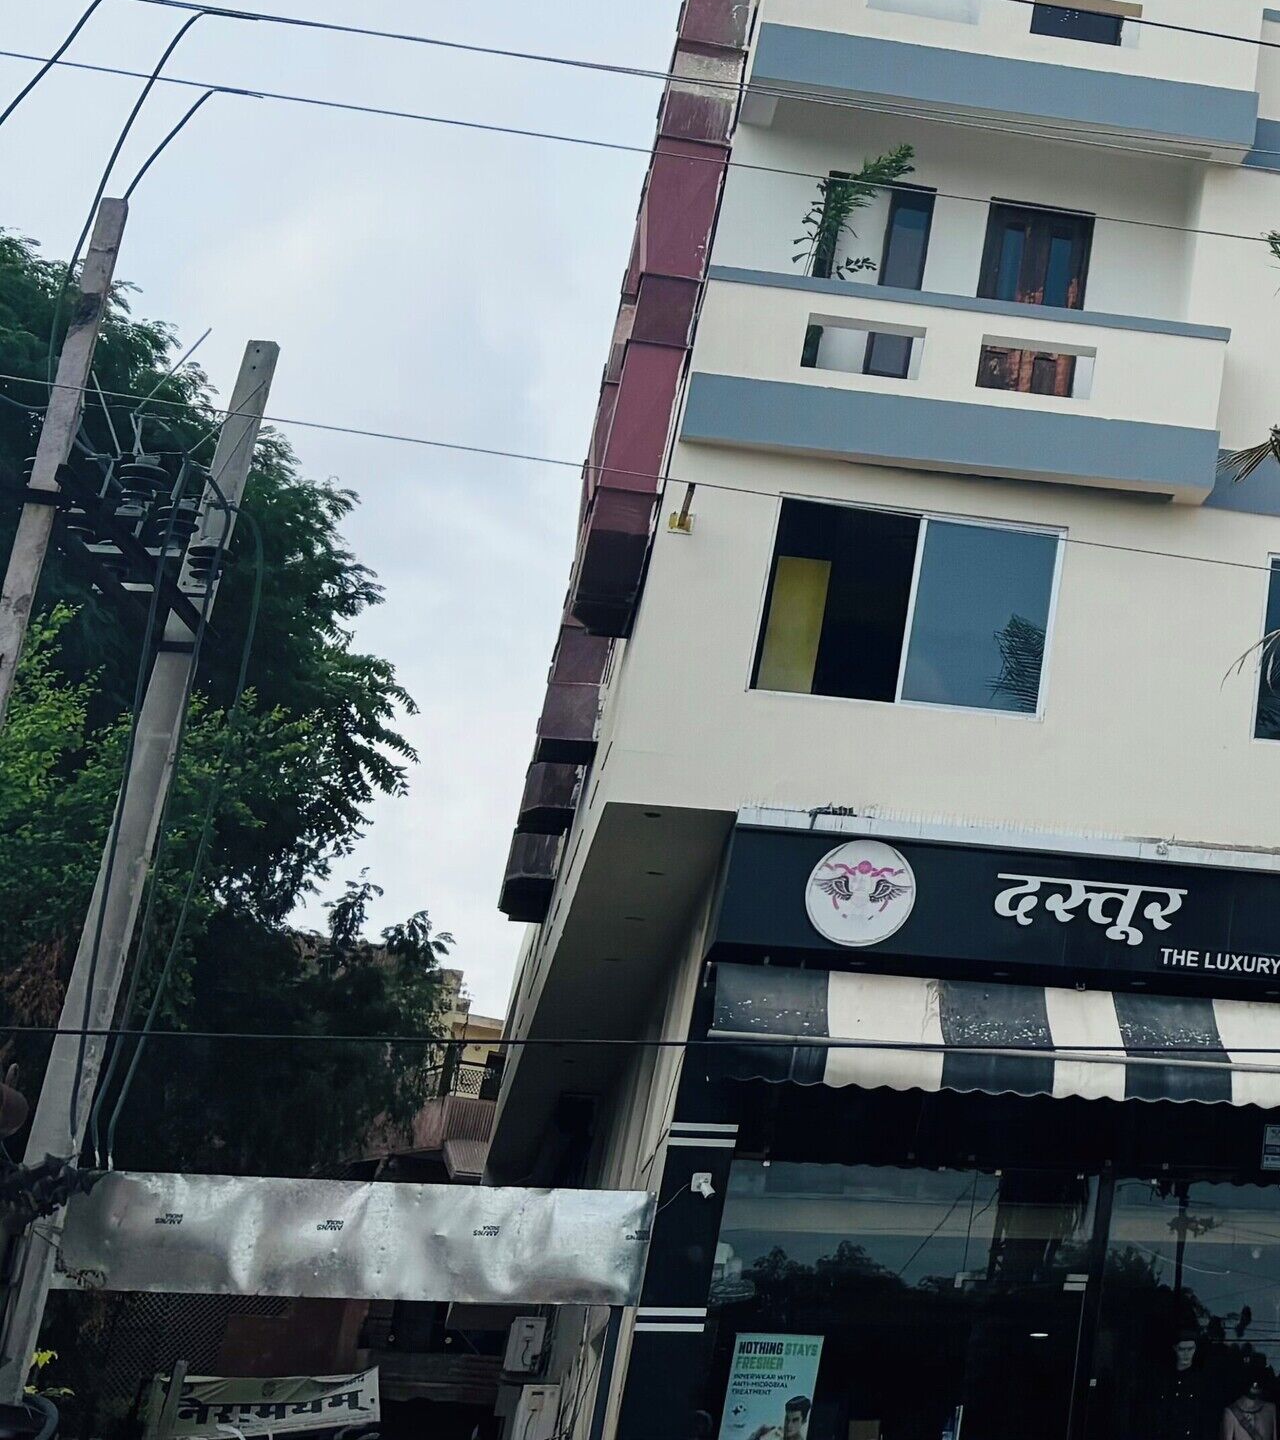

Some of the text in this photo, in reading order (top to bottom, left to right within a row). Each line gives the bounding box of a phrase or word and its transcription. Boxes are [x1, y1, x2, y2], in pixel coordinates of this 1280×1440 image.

[993, 873, 1188, 946] दस्तूर
[1160, 947, 1200, 969] THE
[738, 1341, 819, 1357] NOTHING STAYS
[731, 1388, 772, 1396] TREATMENT
